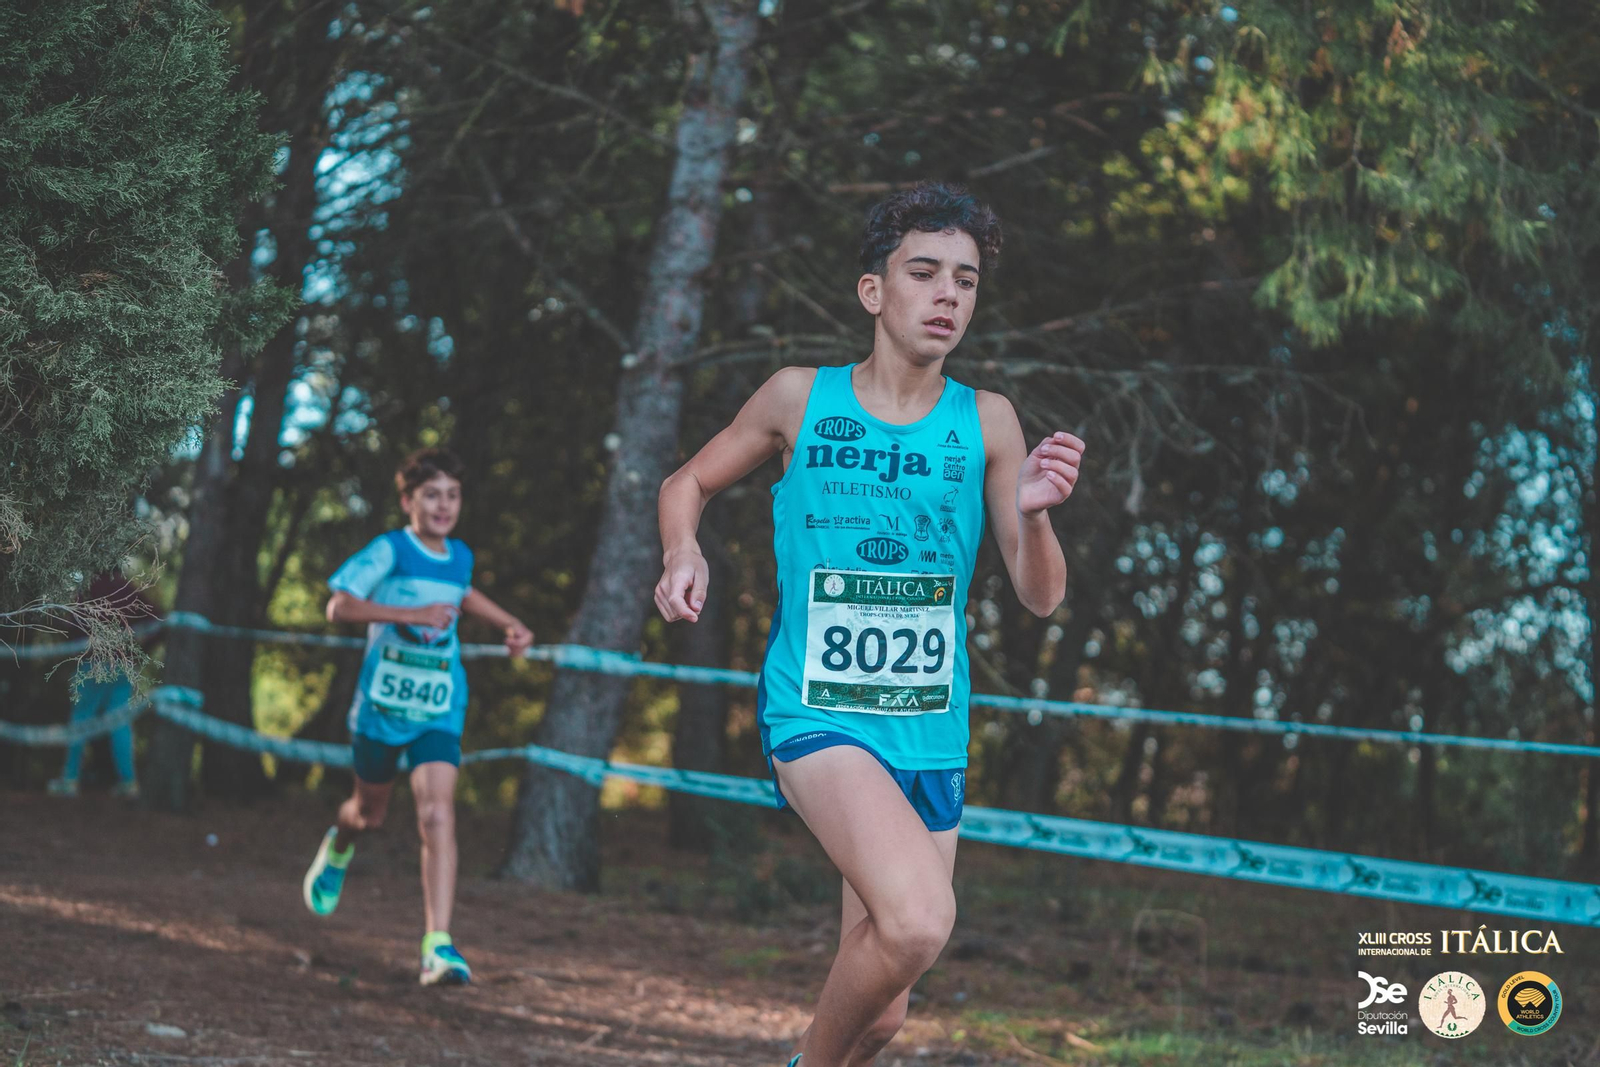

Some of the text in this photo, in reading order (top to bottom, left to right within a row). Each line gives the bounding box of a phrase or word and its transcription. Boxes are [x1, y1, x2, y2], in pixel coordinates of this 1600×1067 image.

[816, 418, 864, 438] TROPS
[806, 443, 932, 483] nerja
[822, 480, 912, 500] ATLETISMO
[845, 515, 870, 525] activa
[858, 539, 907, 560] TROPS
[855, 577, 925, 596] ITÁLICA
[821, 625, 946, 674] 8029
[380, 674, 448, 706] 5840
